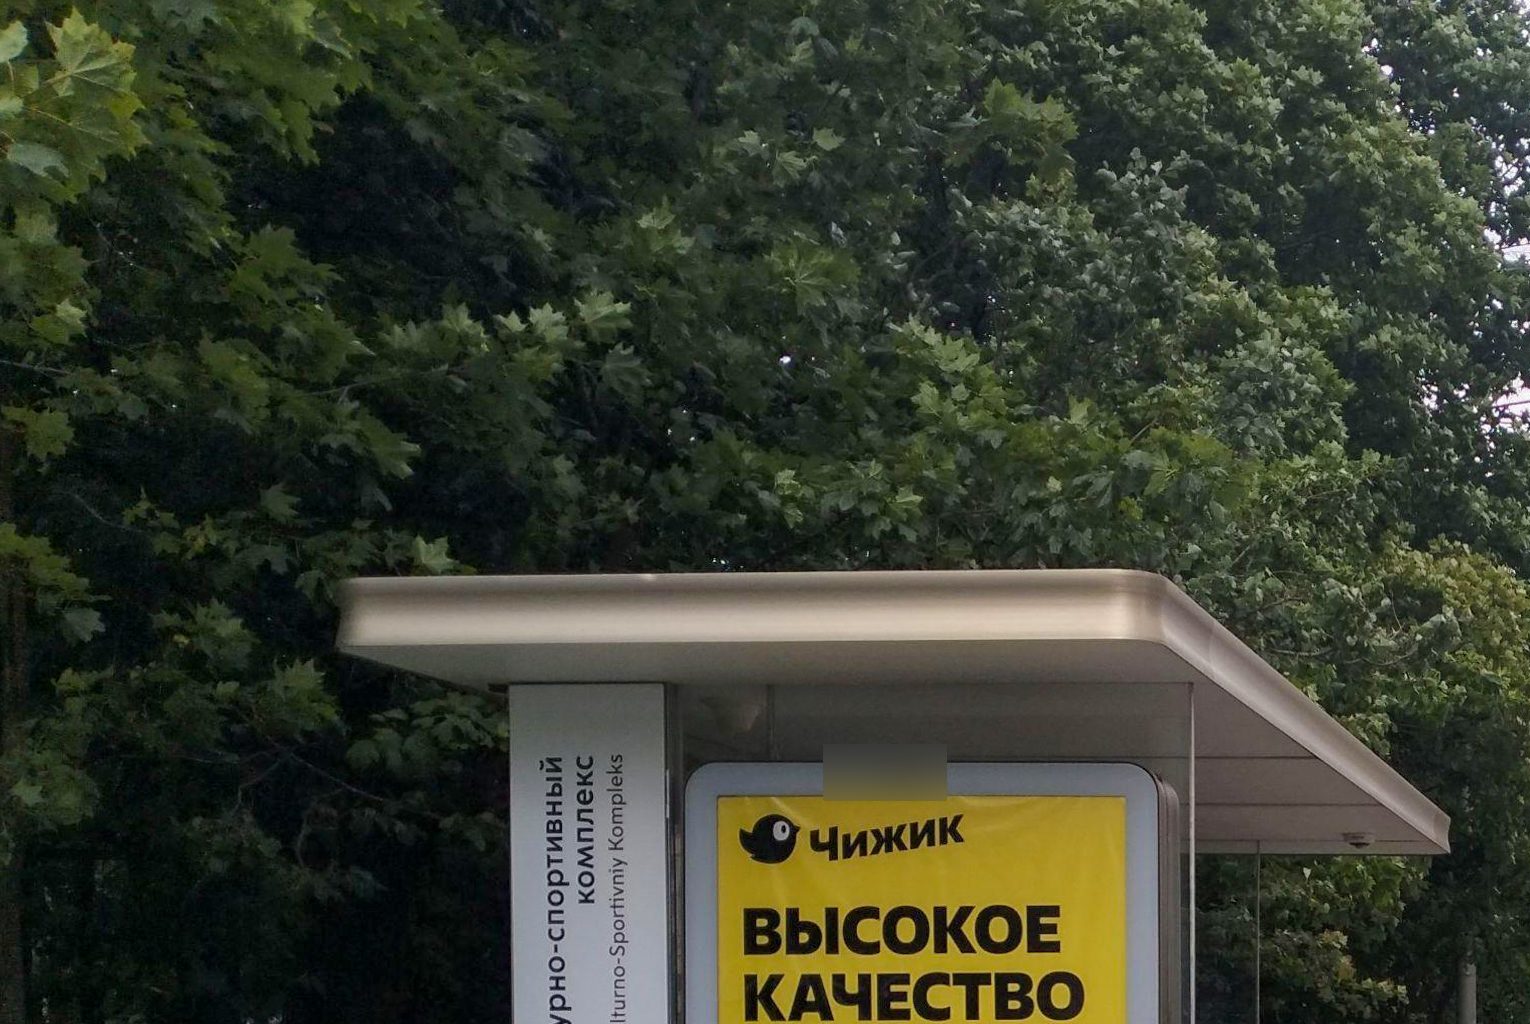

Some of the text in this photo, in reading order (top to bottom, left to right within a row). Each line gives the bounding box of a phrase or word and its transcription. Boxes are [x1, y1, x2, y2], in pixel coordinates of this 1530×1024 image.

[576, 756, 595, 904] комплекс
[606, 754, 627, 851] Kompleks
[743, 905, 1061, 955] ВЫСОКОЕ
[744, 972, 1085, 1021] КАЧЕСТВО
